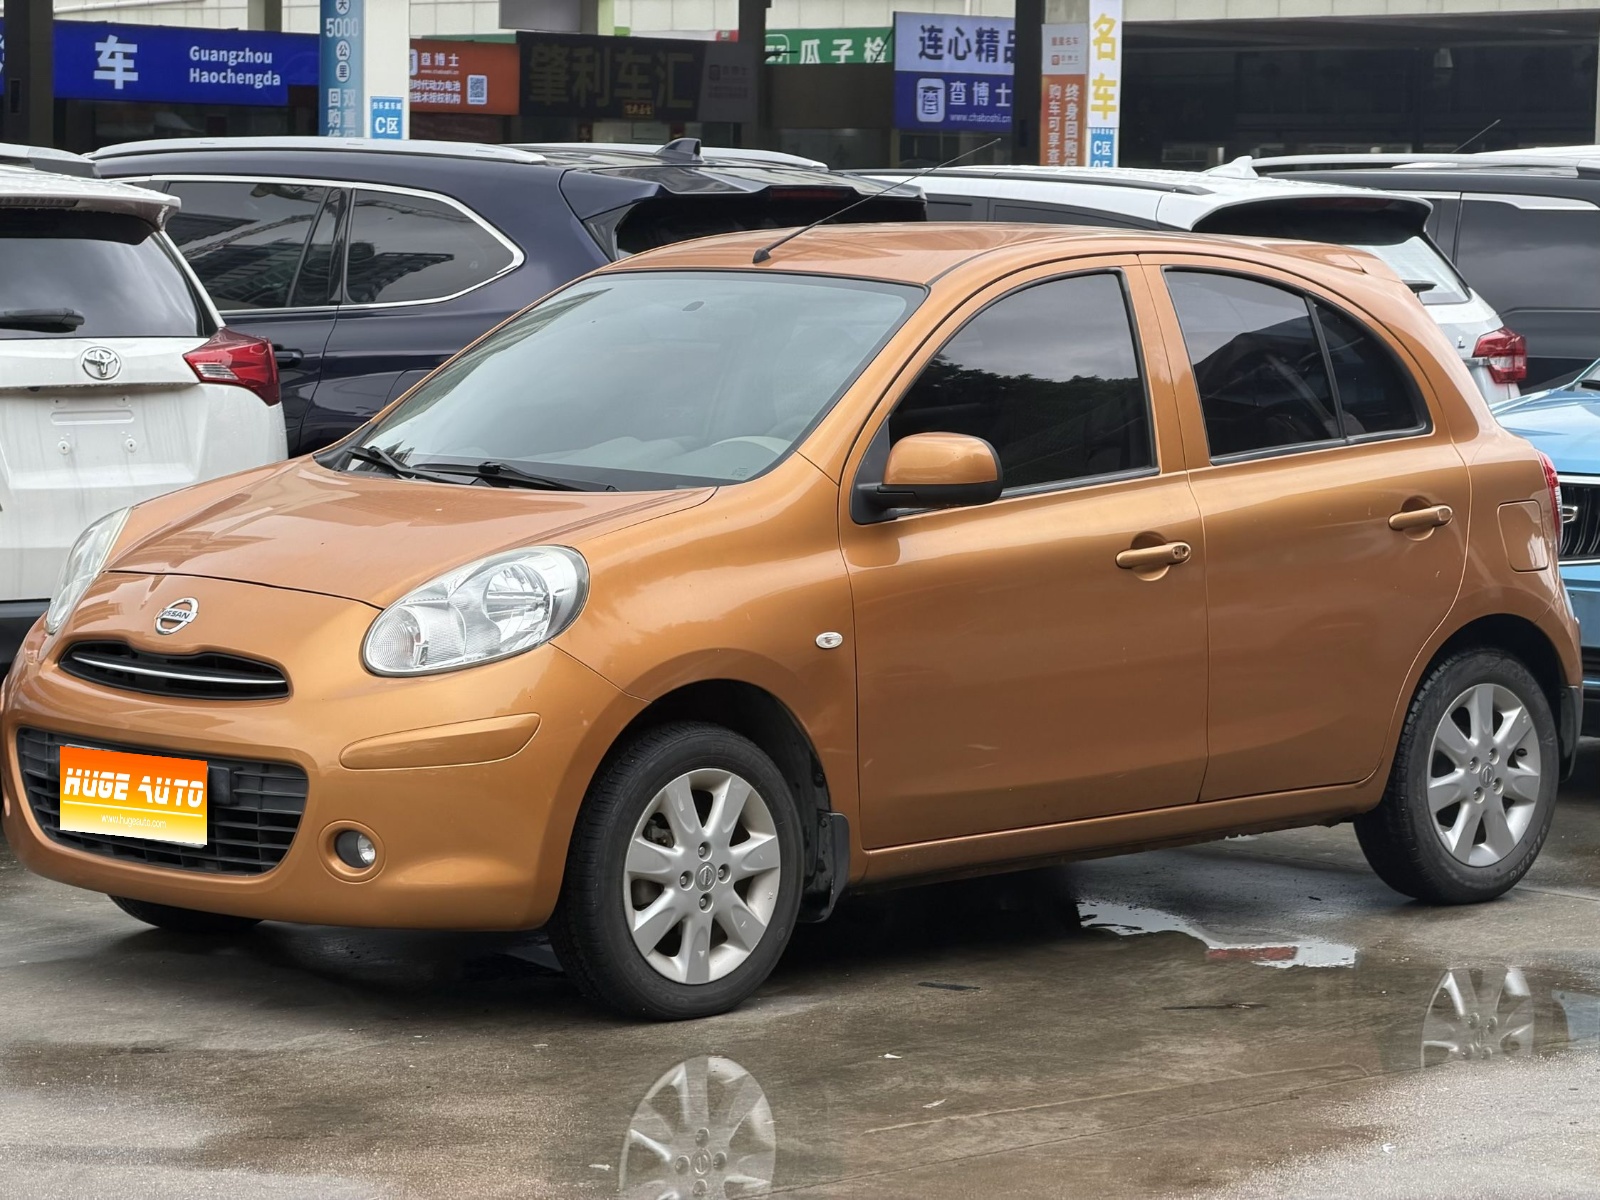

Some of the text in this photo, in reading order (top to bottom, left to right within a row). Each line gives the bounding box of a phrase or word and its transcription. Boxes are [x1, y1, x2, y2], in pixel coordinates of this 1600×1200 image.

[326, 18, 359, 37] 5000
[189, 46, 273, 66] Guangzhou
[799, 37, 887, 64] 瓜子检
[918, 25, 1015, 63] 连心精品
[93, 34, 139, 90] 车
[338, 44, 348, 78] 公里
[421, 52, 460, 67] 查博士
[1091, 14, 1117, 120] 名车
[189, 68, 282, 89] Haochengda
[950, 80, 1013, 107] 查博士
[375, 117, 399, 134] C区
[949, 113, 1012, 124] www.chaboshi.cn
[1047, 83, 1062, 167] 购车可享查
[1093, 140, 1112, 156] C区
